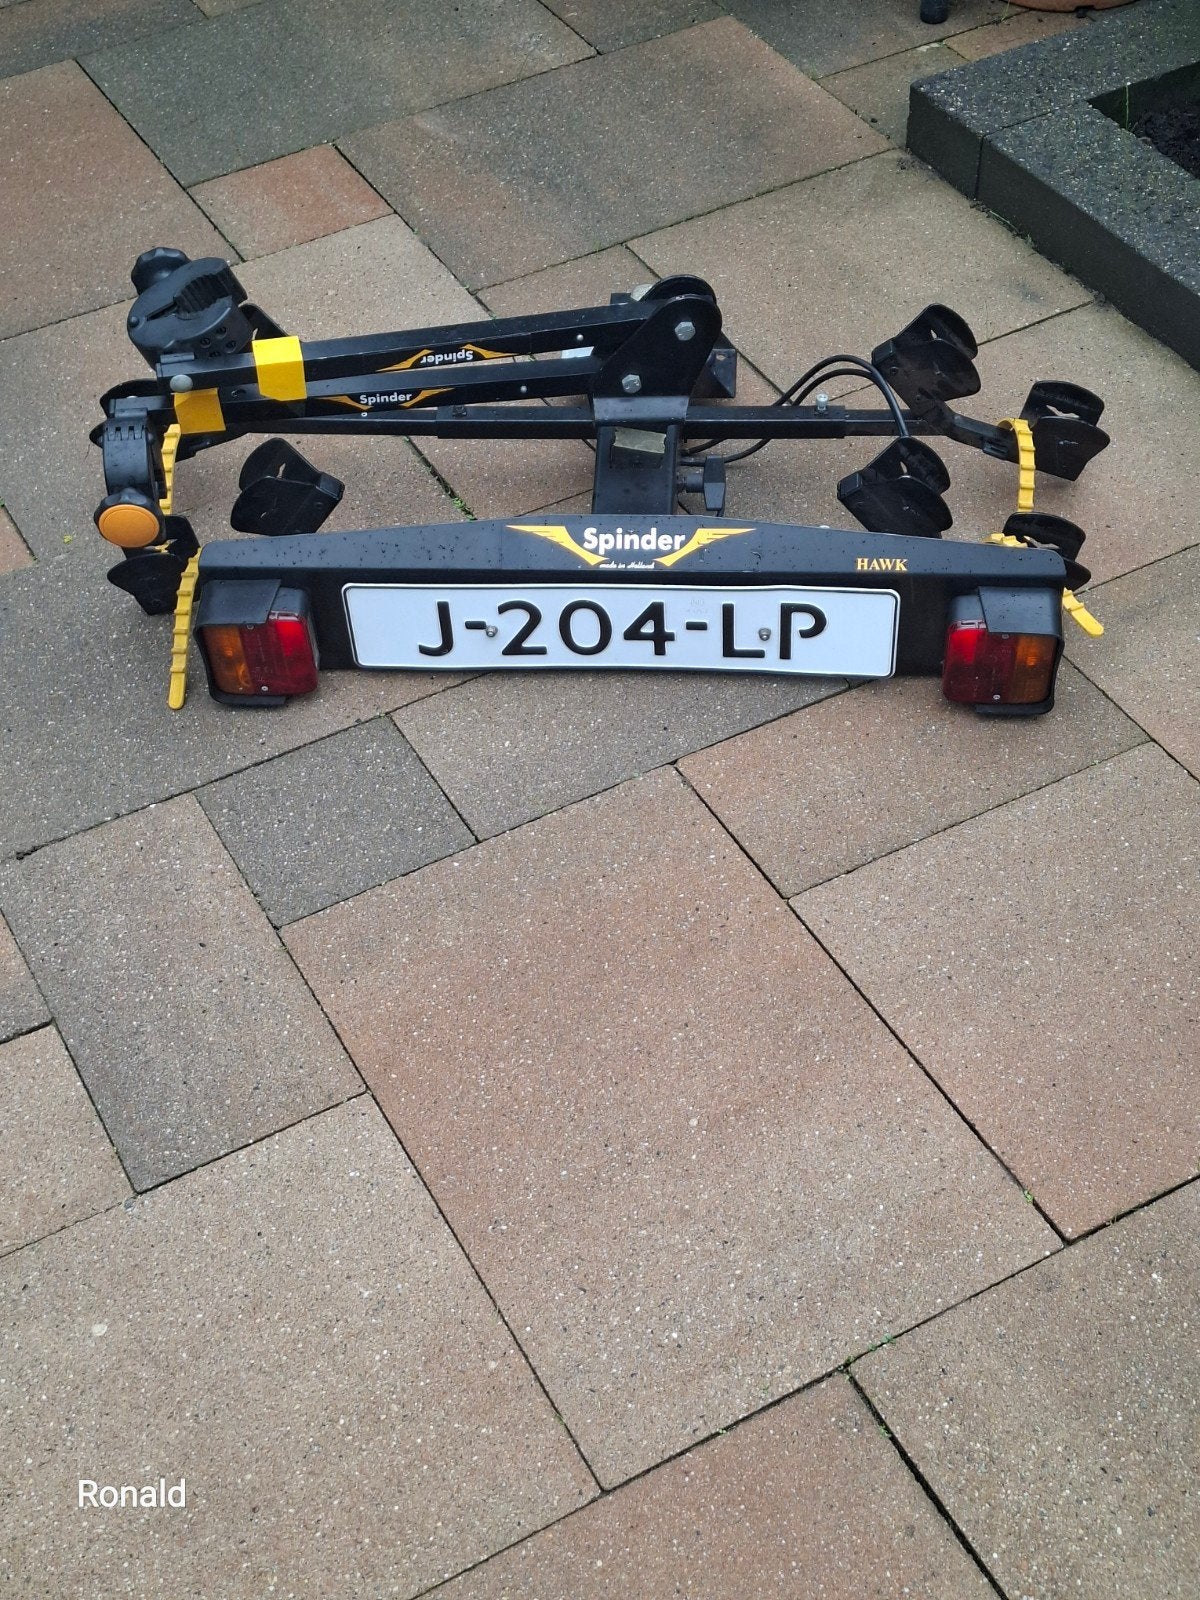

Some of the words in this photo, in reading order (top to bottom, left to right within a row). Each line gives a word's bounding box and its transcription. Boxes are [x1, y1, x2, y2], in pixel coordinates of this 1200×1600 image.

[420, 348, 474, 365] Spinder
[359, 391, 413, 406] Spinder
[583, 527, 686, 556] Spinder
[856, 557, 908, 571] HAWK
[417, 599, 828, 660] J-204-LP
